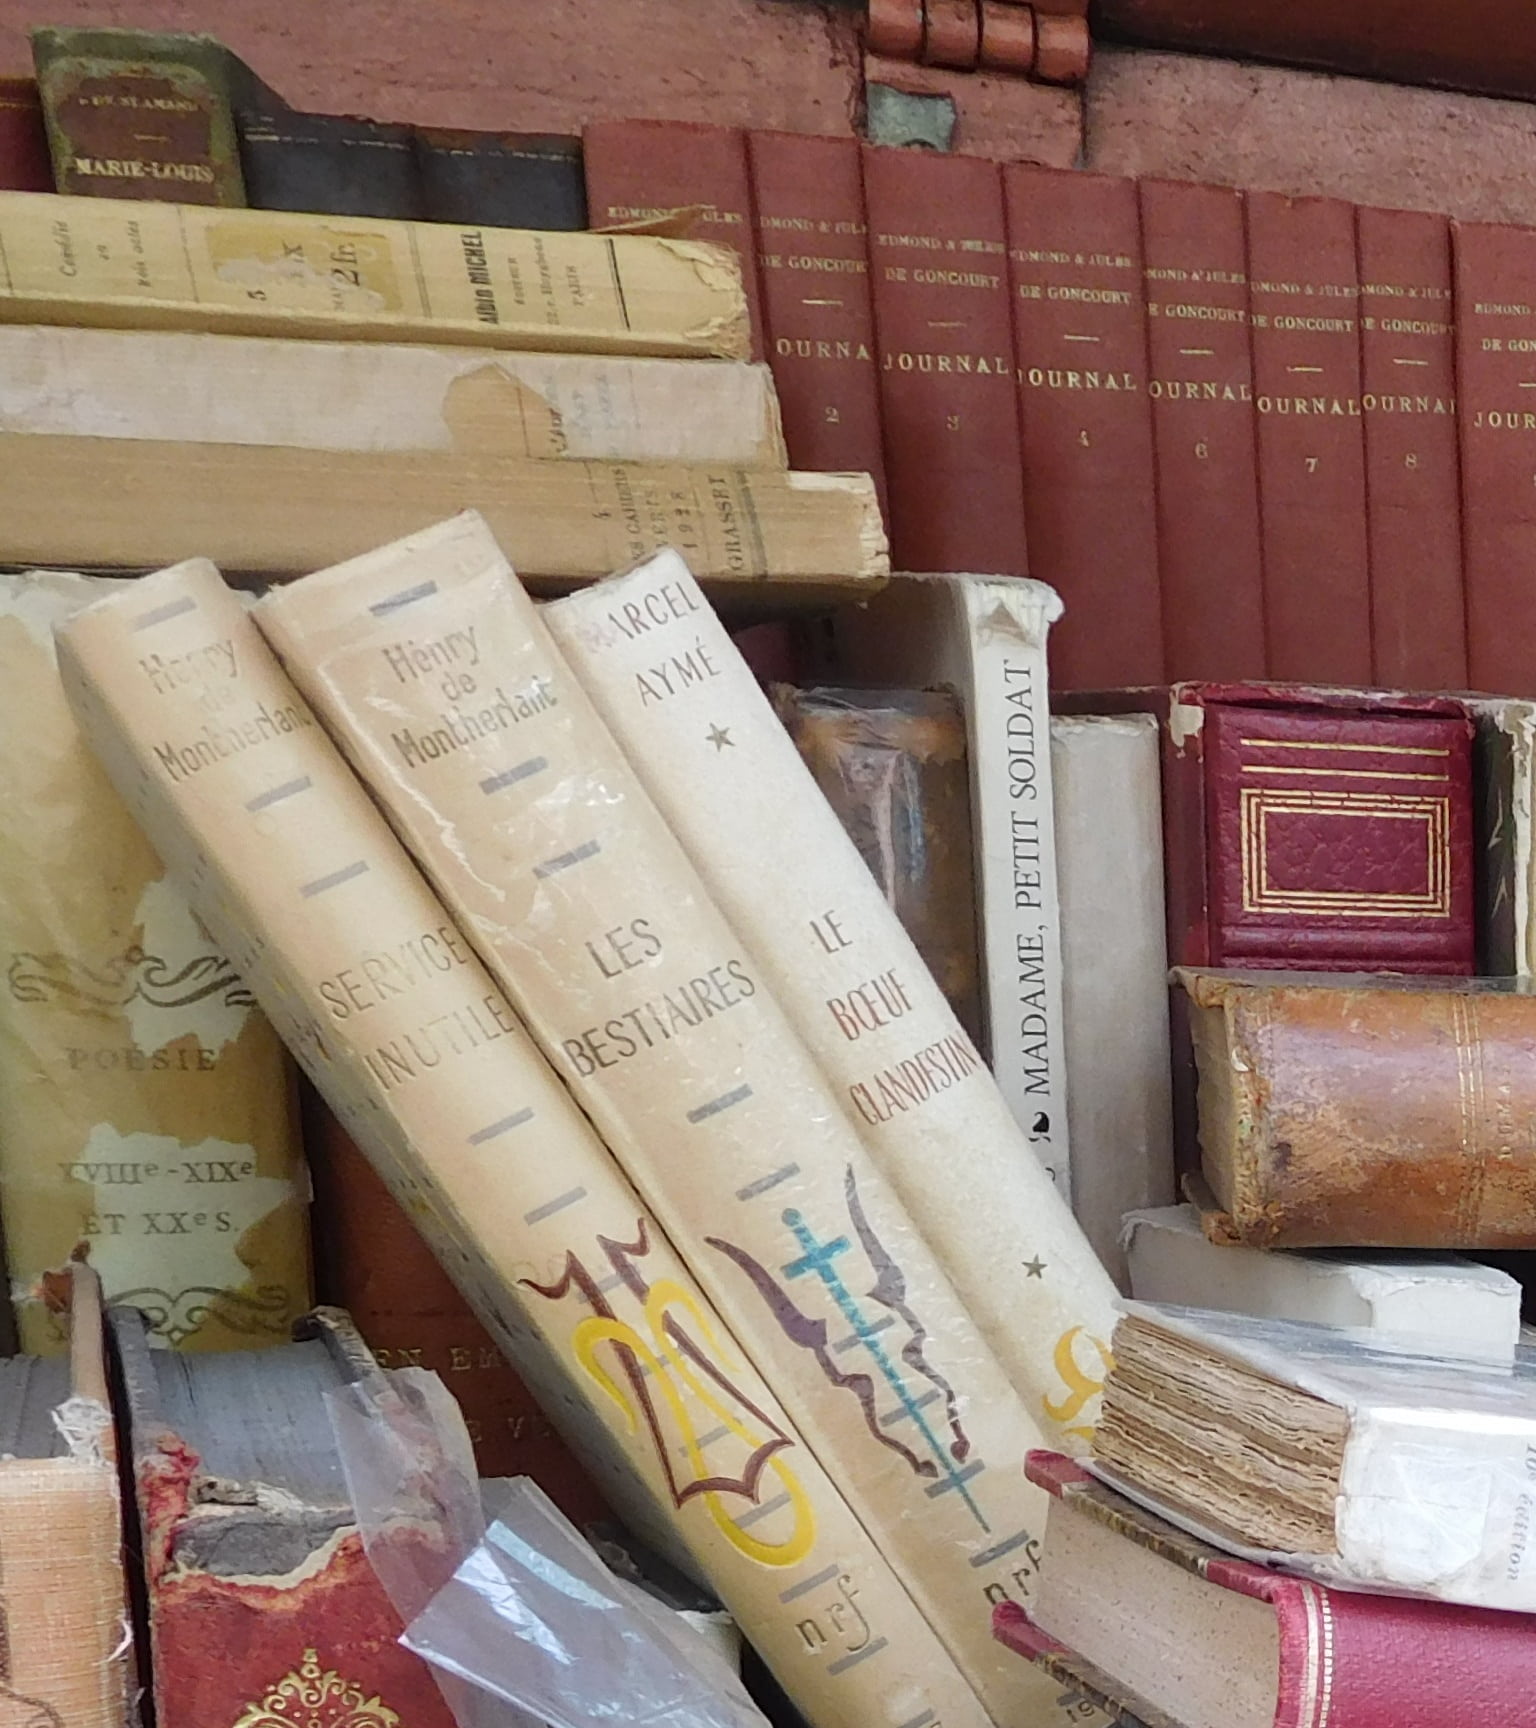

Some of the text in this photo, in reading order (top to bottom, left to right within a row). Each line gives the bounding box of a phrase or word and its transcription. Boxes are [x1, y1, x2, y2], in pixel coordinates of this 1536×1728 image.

[912, 268, 1000, 290] GONCOURT
[1046, 286, 1132, 305] GONCOURT
[1273, 316, 1356, 334] GONCOURT
[882, 352, 1010, 376] JOURNAL
[1404, 452, 1418, 470] 8
[136, 636, 241, 696] Henry
[379, 625, 482, 686] Henry
[439, 668, 480, 704] de
[633, 636, 723, 710] AYMÉ
[153, 701, 312, 784] Montherlant
[390, 678, 562, 770] Montherlant
[1004, 657, 1054, 1098] MADAME, PETIT SOLDAT
[582, 916, 664, 982] LES
[807, 907, 856, 956] LE
[318, 924, 469, 1023] SERVICE
[824, 965, 918, 1044] BŒUF
[364, 992, 517, 1094] INUTILE
[559, 956, 758, 1082] BESTIAIRES
[846, 1028, 985, 1130] CLANDESTIN
[82, 1211, 126, 1238] ET
